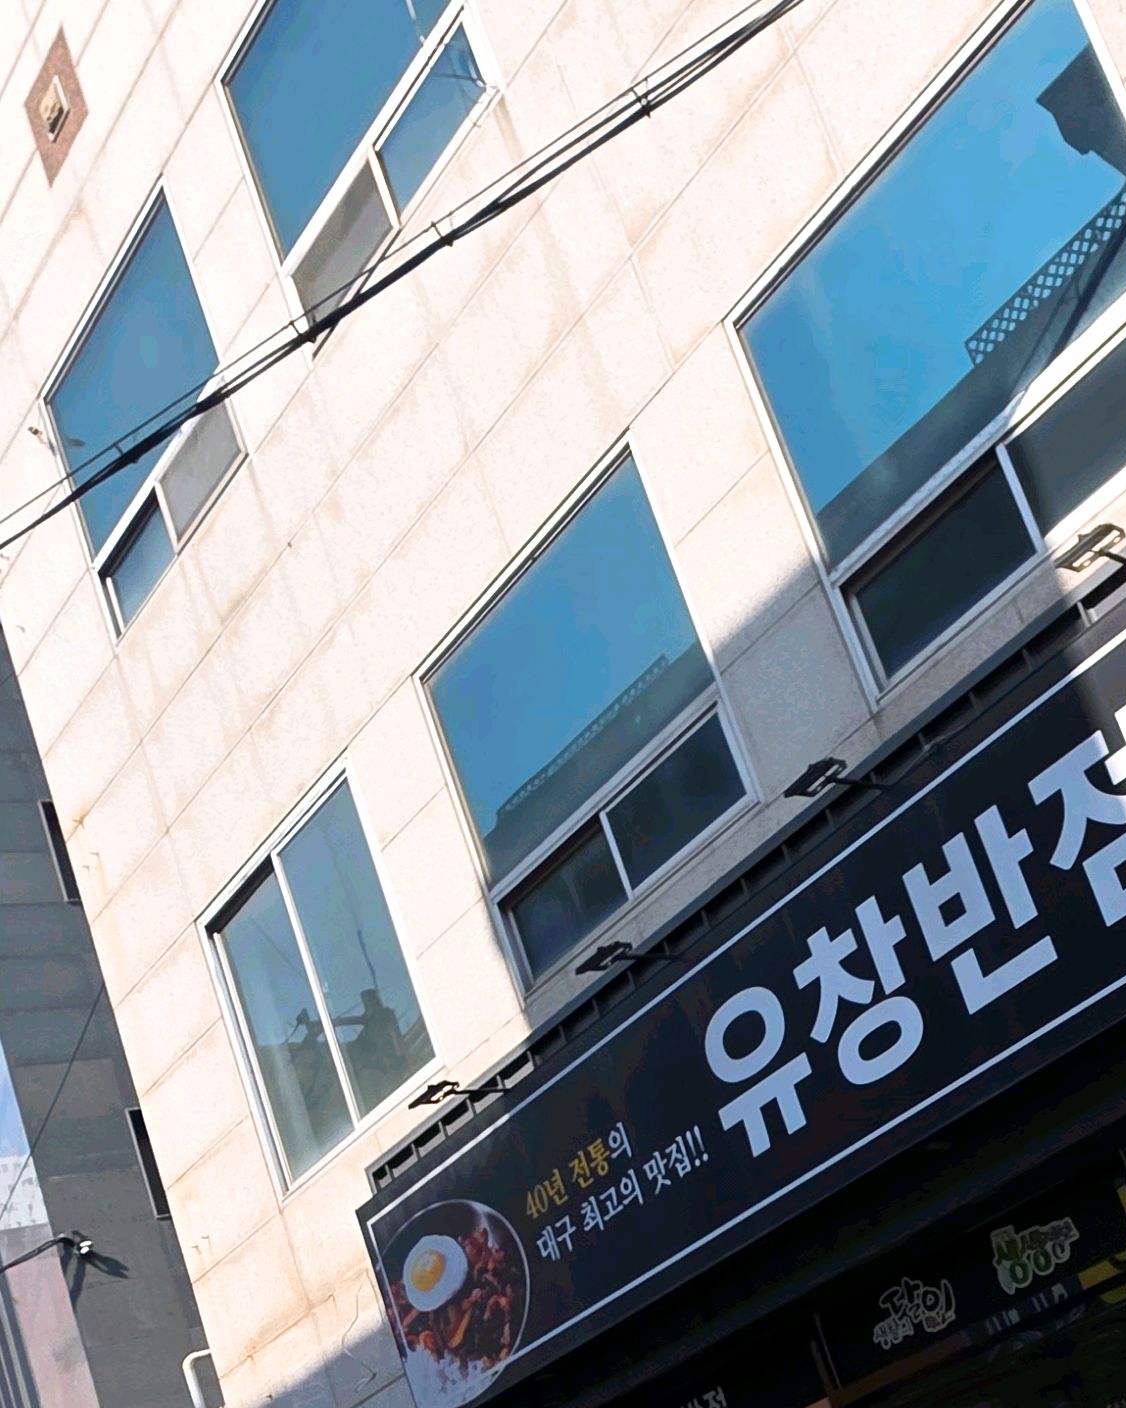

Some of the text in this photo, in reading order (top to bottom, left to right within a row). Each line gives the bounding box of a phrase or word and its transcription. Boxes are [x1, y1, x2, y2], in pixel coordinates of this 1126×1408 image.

[525, 1121, 633, 1219] 40년 전통의
[536, 1124, 709, 1261] 대구 최고의 맛집!!
